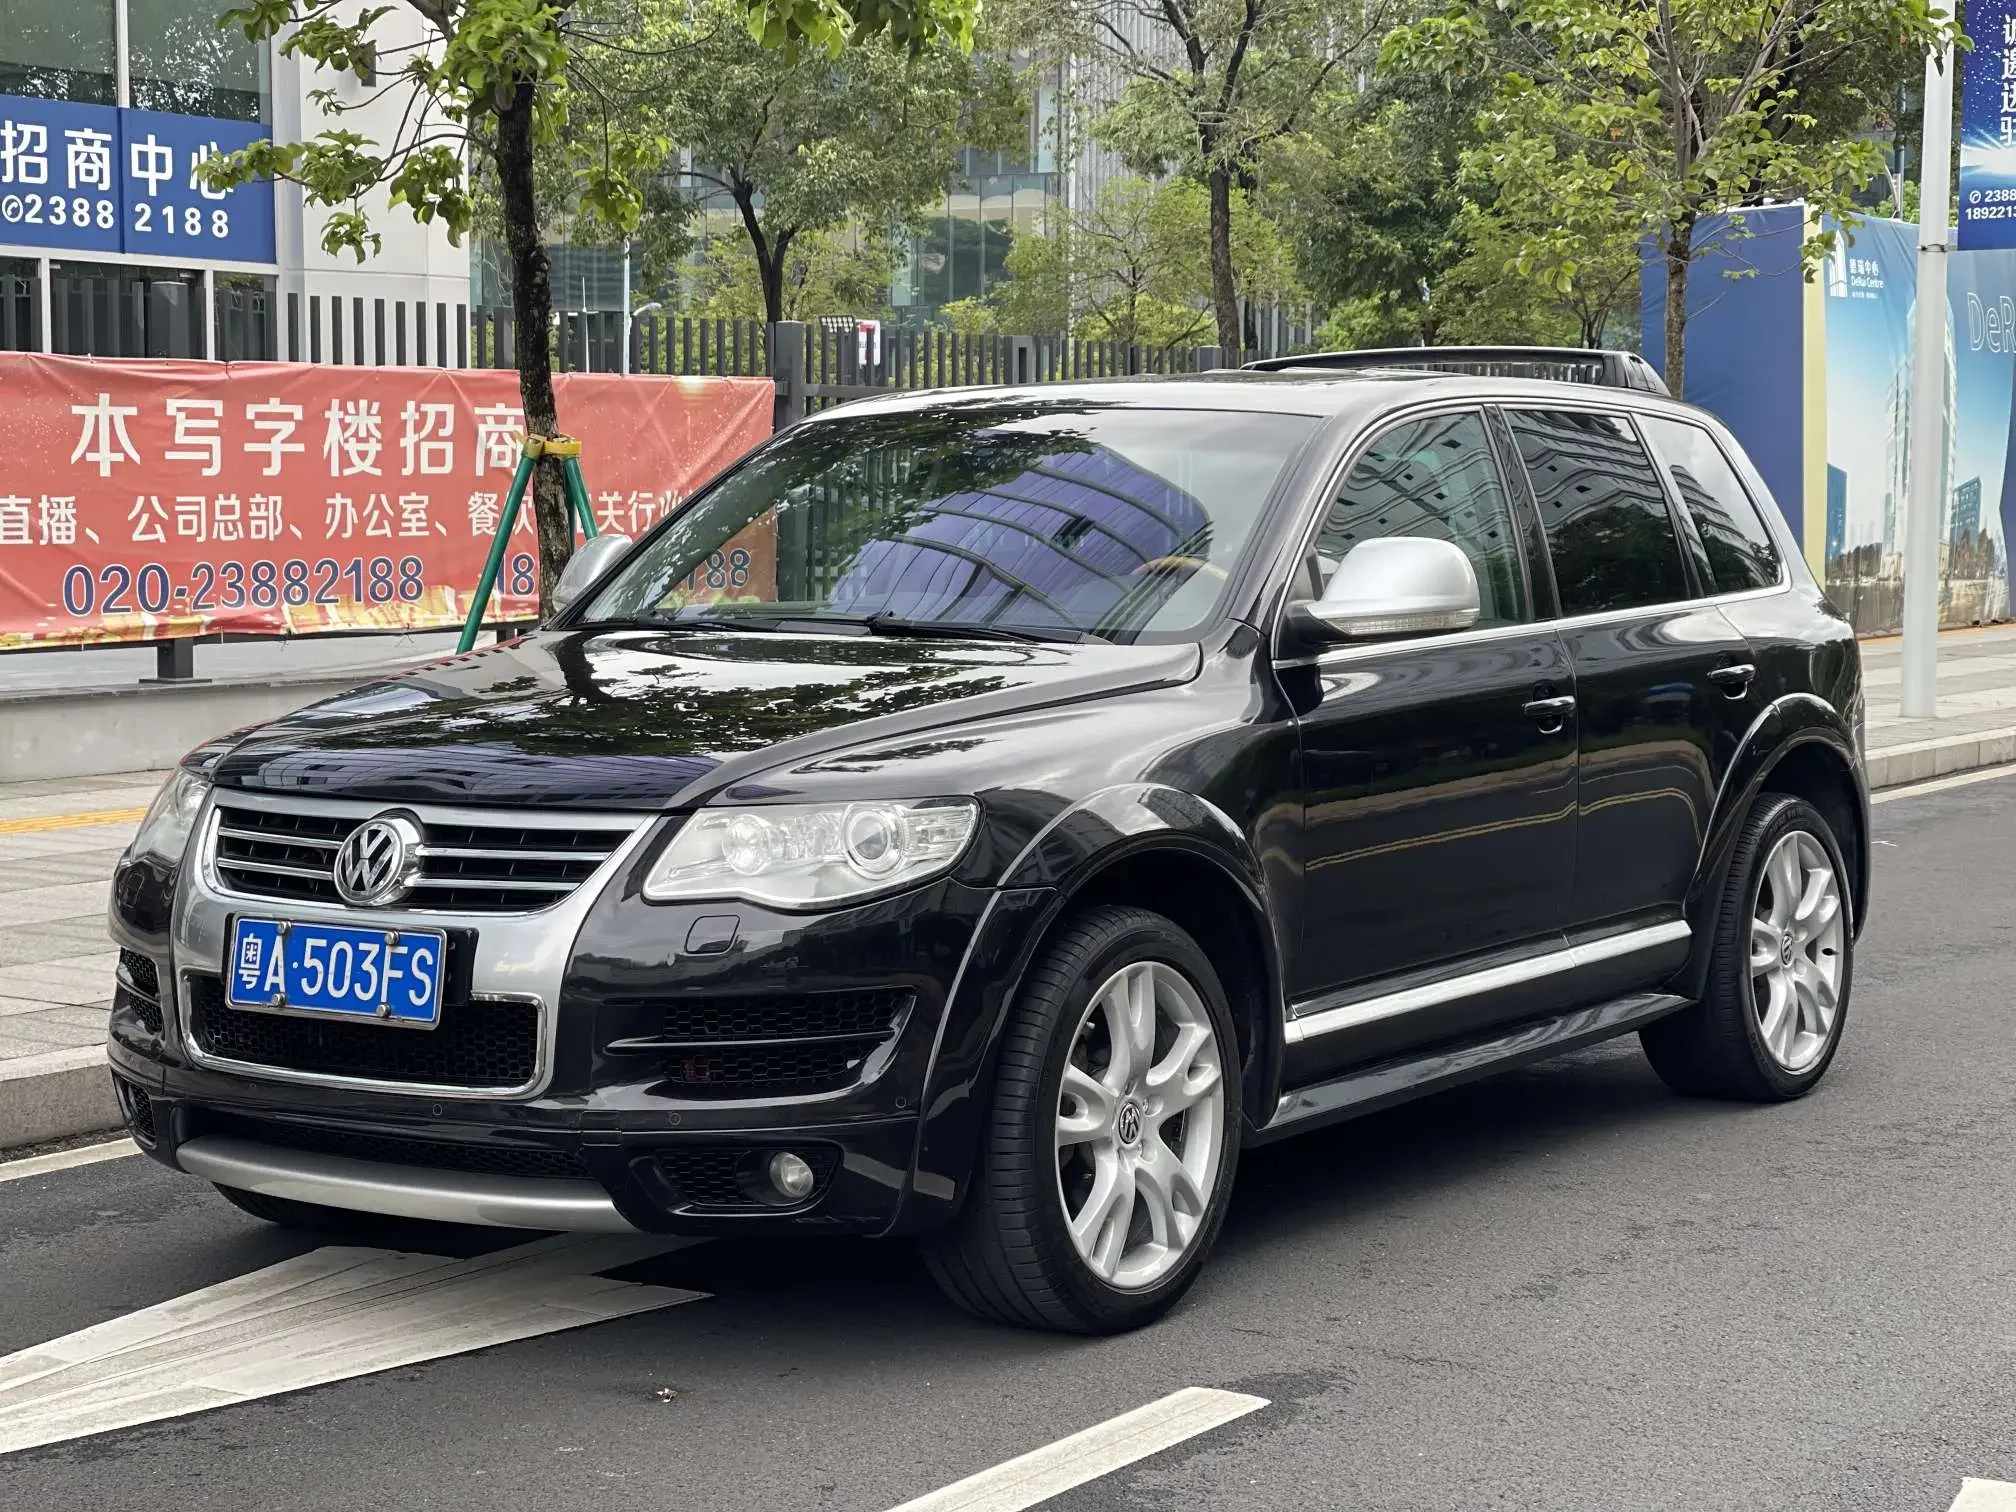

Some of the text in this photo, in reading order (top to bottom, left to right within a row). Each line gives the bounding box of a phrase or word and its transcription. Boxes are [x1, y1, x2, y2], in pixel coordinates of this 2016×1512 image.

[0, 119, 234, 200] 招商中心
[24, 193, 229, 238] 2388 2188
[71, 392, 525, 478] 本写字楼招商
[62, 555, 424, 617] 020-23882188
